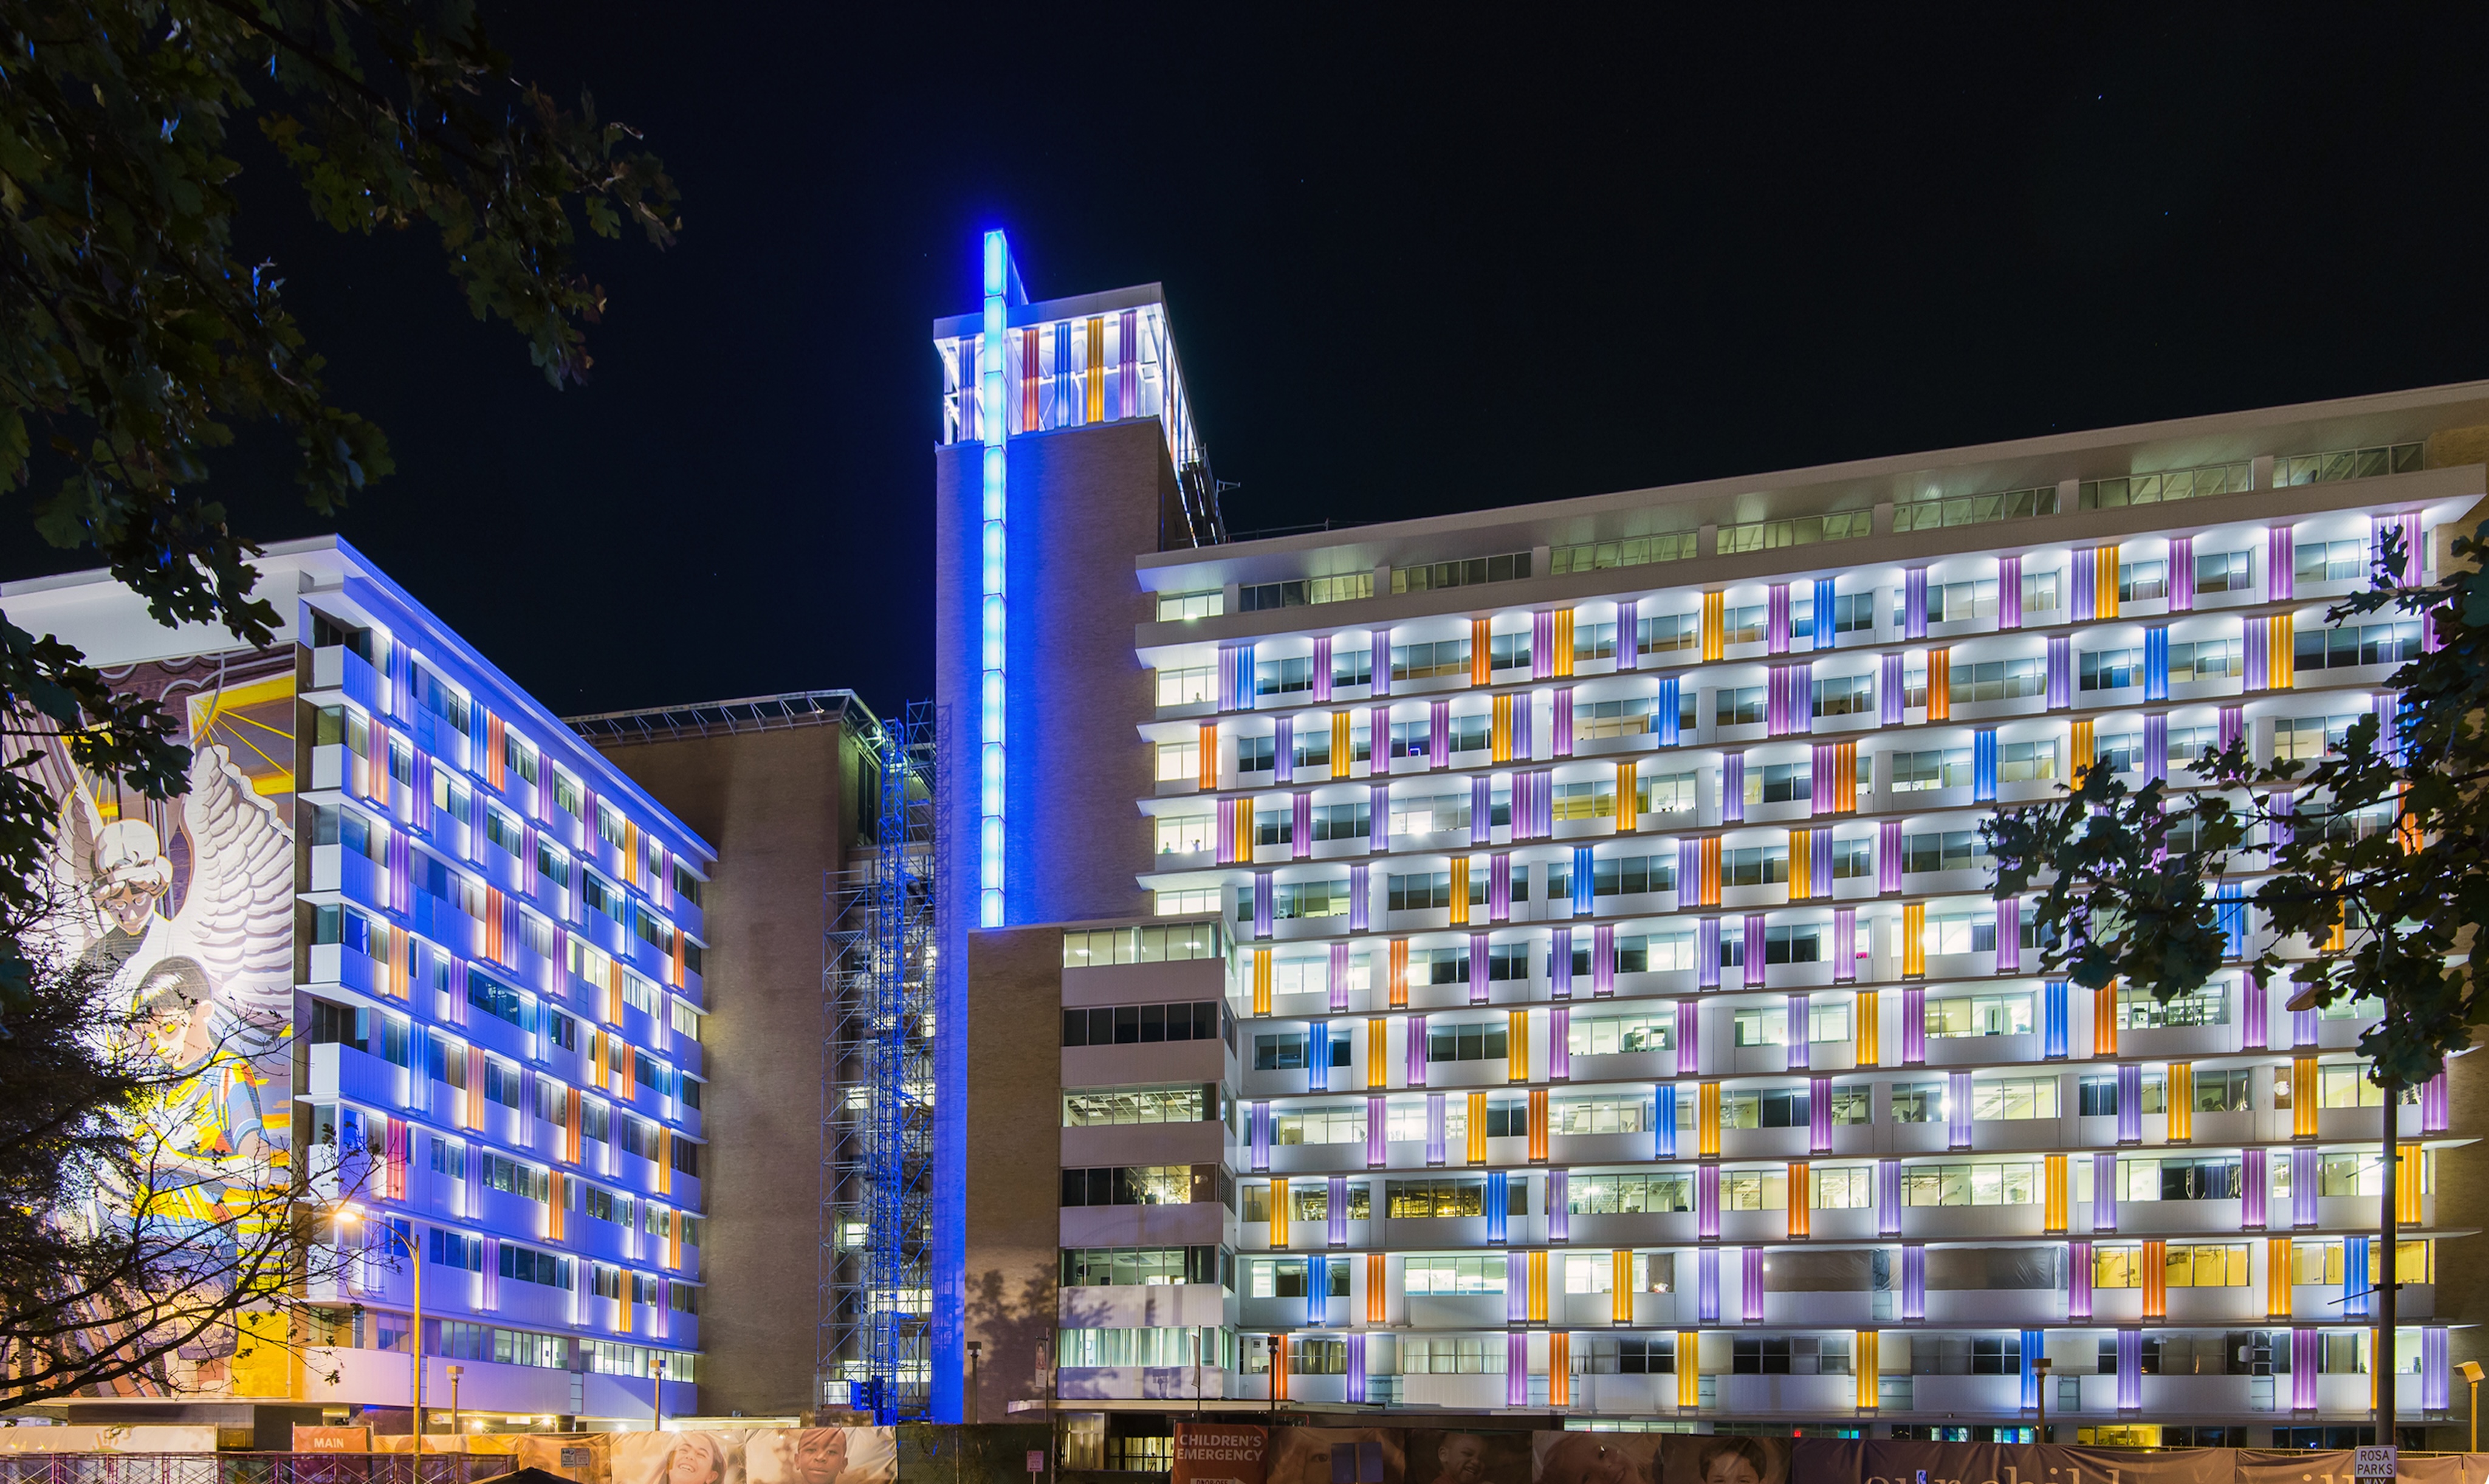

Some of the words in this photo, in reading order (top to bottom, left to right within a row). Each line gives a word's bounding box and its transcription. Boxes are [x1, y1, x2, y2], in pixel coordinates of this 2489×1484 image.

[314, 1438, 344, 1448] MAIN
[1179, 1434, 1262, 1447] CHILDREN'S
[1177, 1448, 1263, 1461] EMERGENCY
[2360, 1450, 2389, 1461] ROSA
[2358, 1463, 2393, 1475] PARKS
